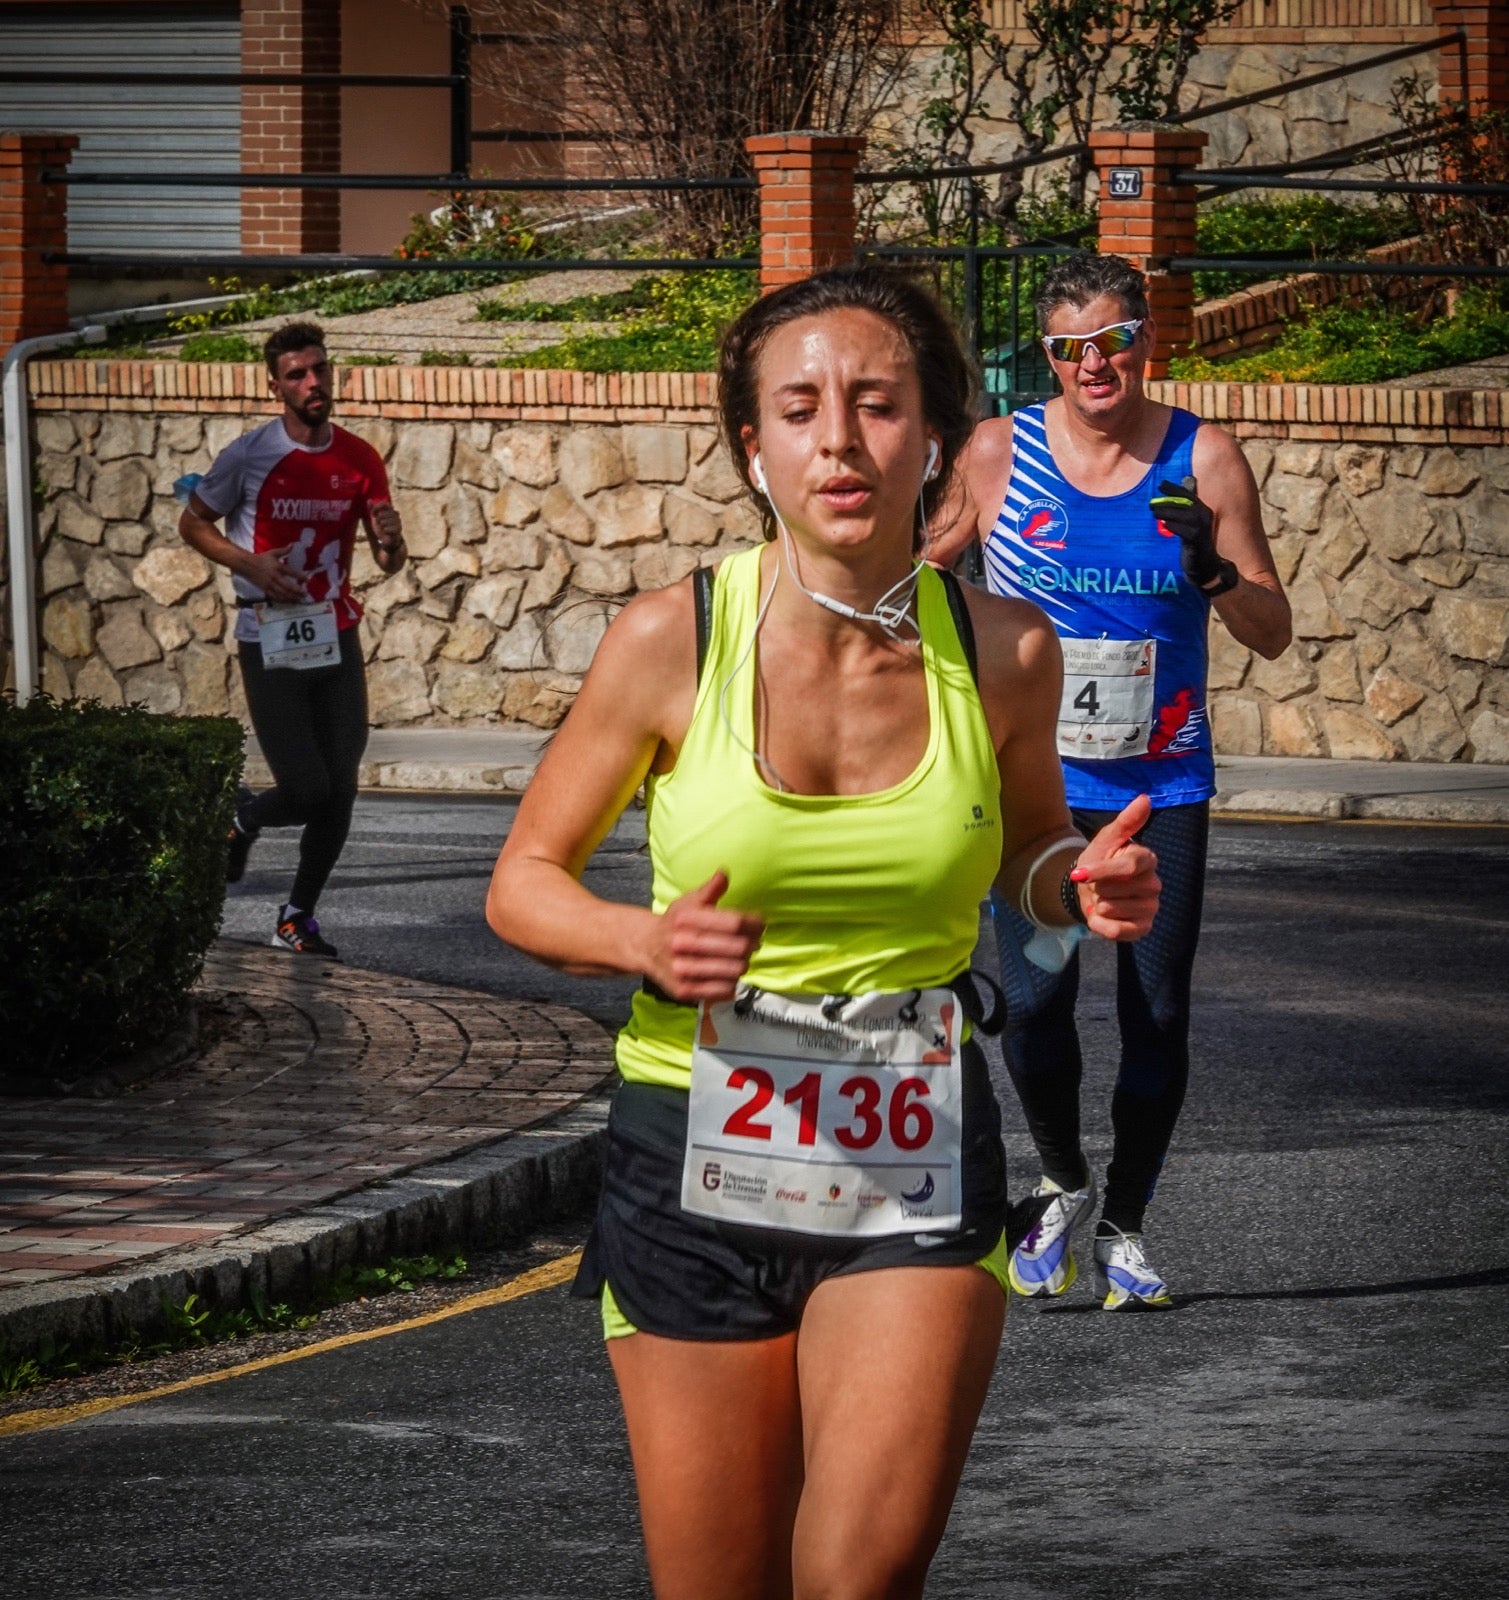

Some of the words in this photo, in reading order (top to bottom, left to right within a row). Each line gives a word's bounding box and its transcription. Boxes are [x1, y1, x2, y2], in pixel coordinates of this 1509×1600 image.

[1115, 173, 1136, 193] 37
[1028, 501, 1057, 511] HUELLAS
[1018, 563, 1179, 595] SONRIALIA
[285, 619, 316, 643] 46
[1074, 681, 1100, 716] 4
[722, 1066, 934, 1151] 2136
